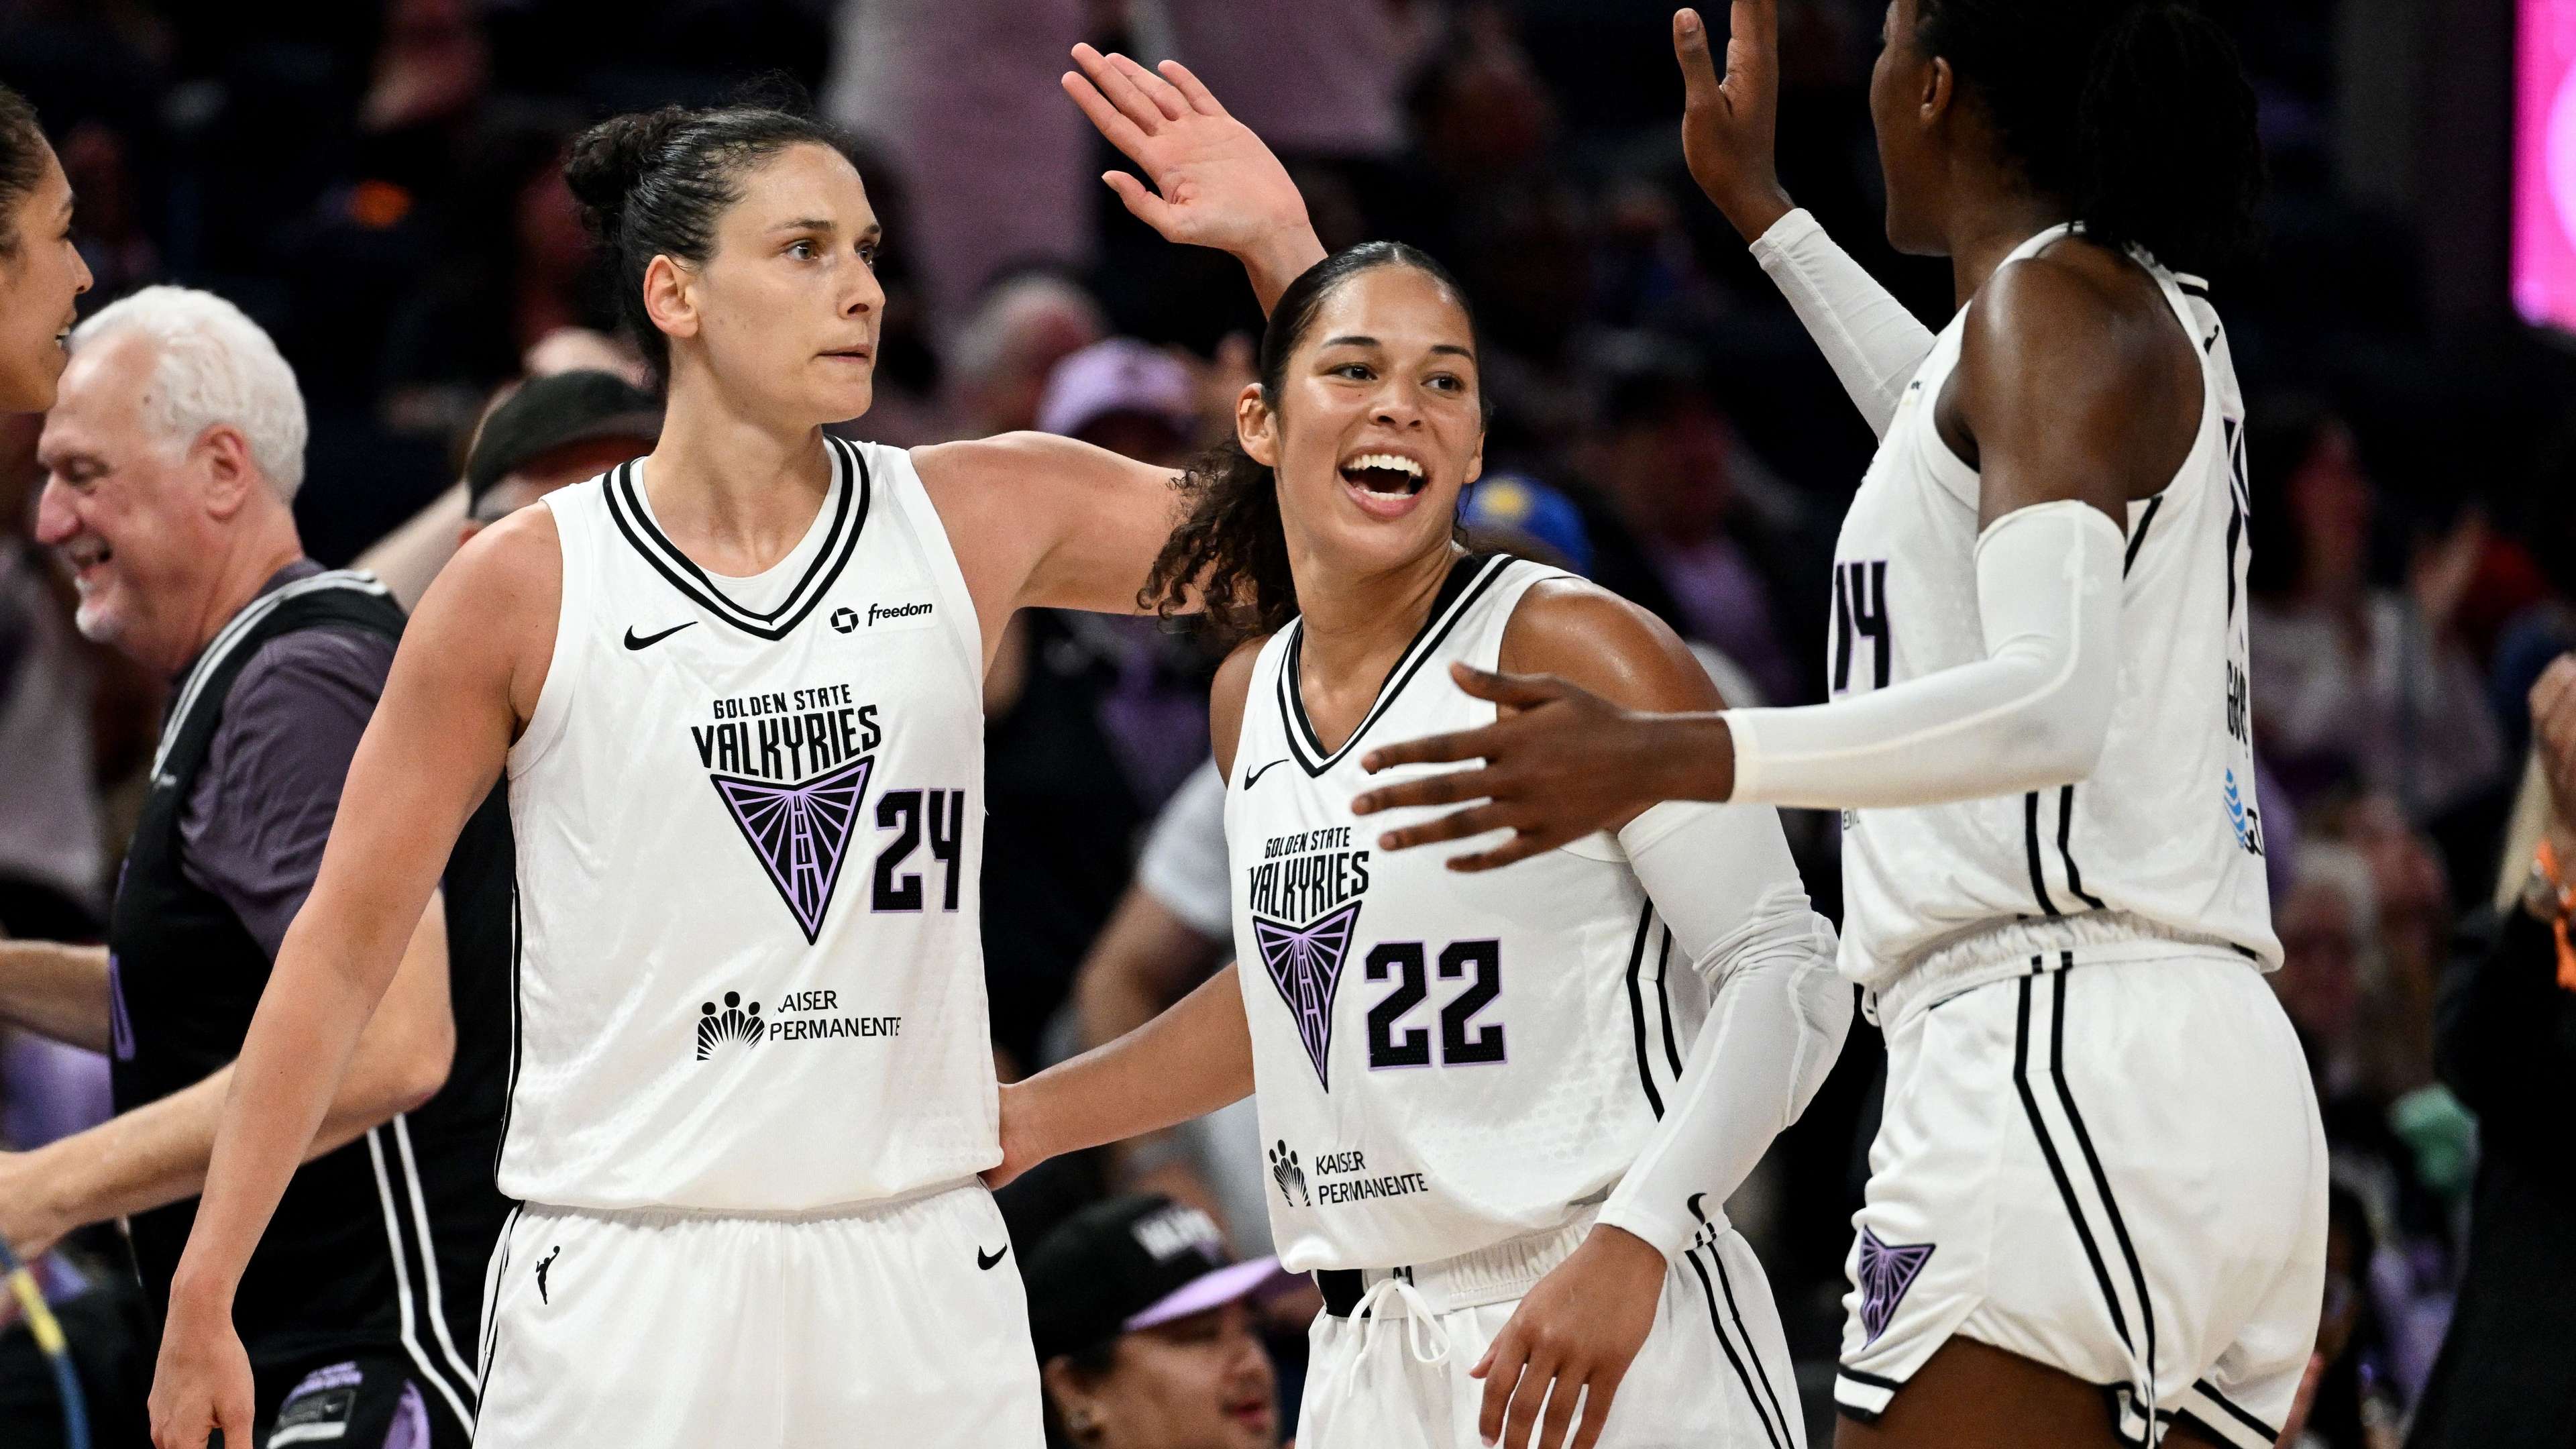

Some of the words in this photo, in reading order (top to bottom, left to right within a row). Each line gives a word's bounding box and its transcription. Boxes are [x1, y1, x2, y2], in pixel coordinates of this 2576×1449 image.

[868, 602, 932, 627] freedom
[714, 693, 788, 719] GOLDEN
[795, 684, 852, 711] STATE
[690, 704, 881, 780] VALKYRIES
[870, 788, 966, 913] 24
[1265, 833, 1307, 859] GOLDEN
[1311, 826, 1351, 850] STATE
[1249, 851, 1369, 923] VALKYRIES
[777, 990, 838, 1013] AISER
[1364, 938, 1507, 1071] 22
[770, 1017, 902, 1041] PERMANENTE
[1316, 1150, 1366, 1175] KAISER
[1318, 1173, 1428, 1205] PERMANENTE
